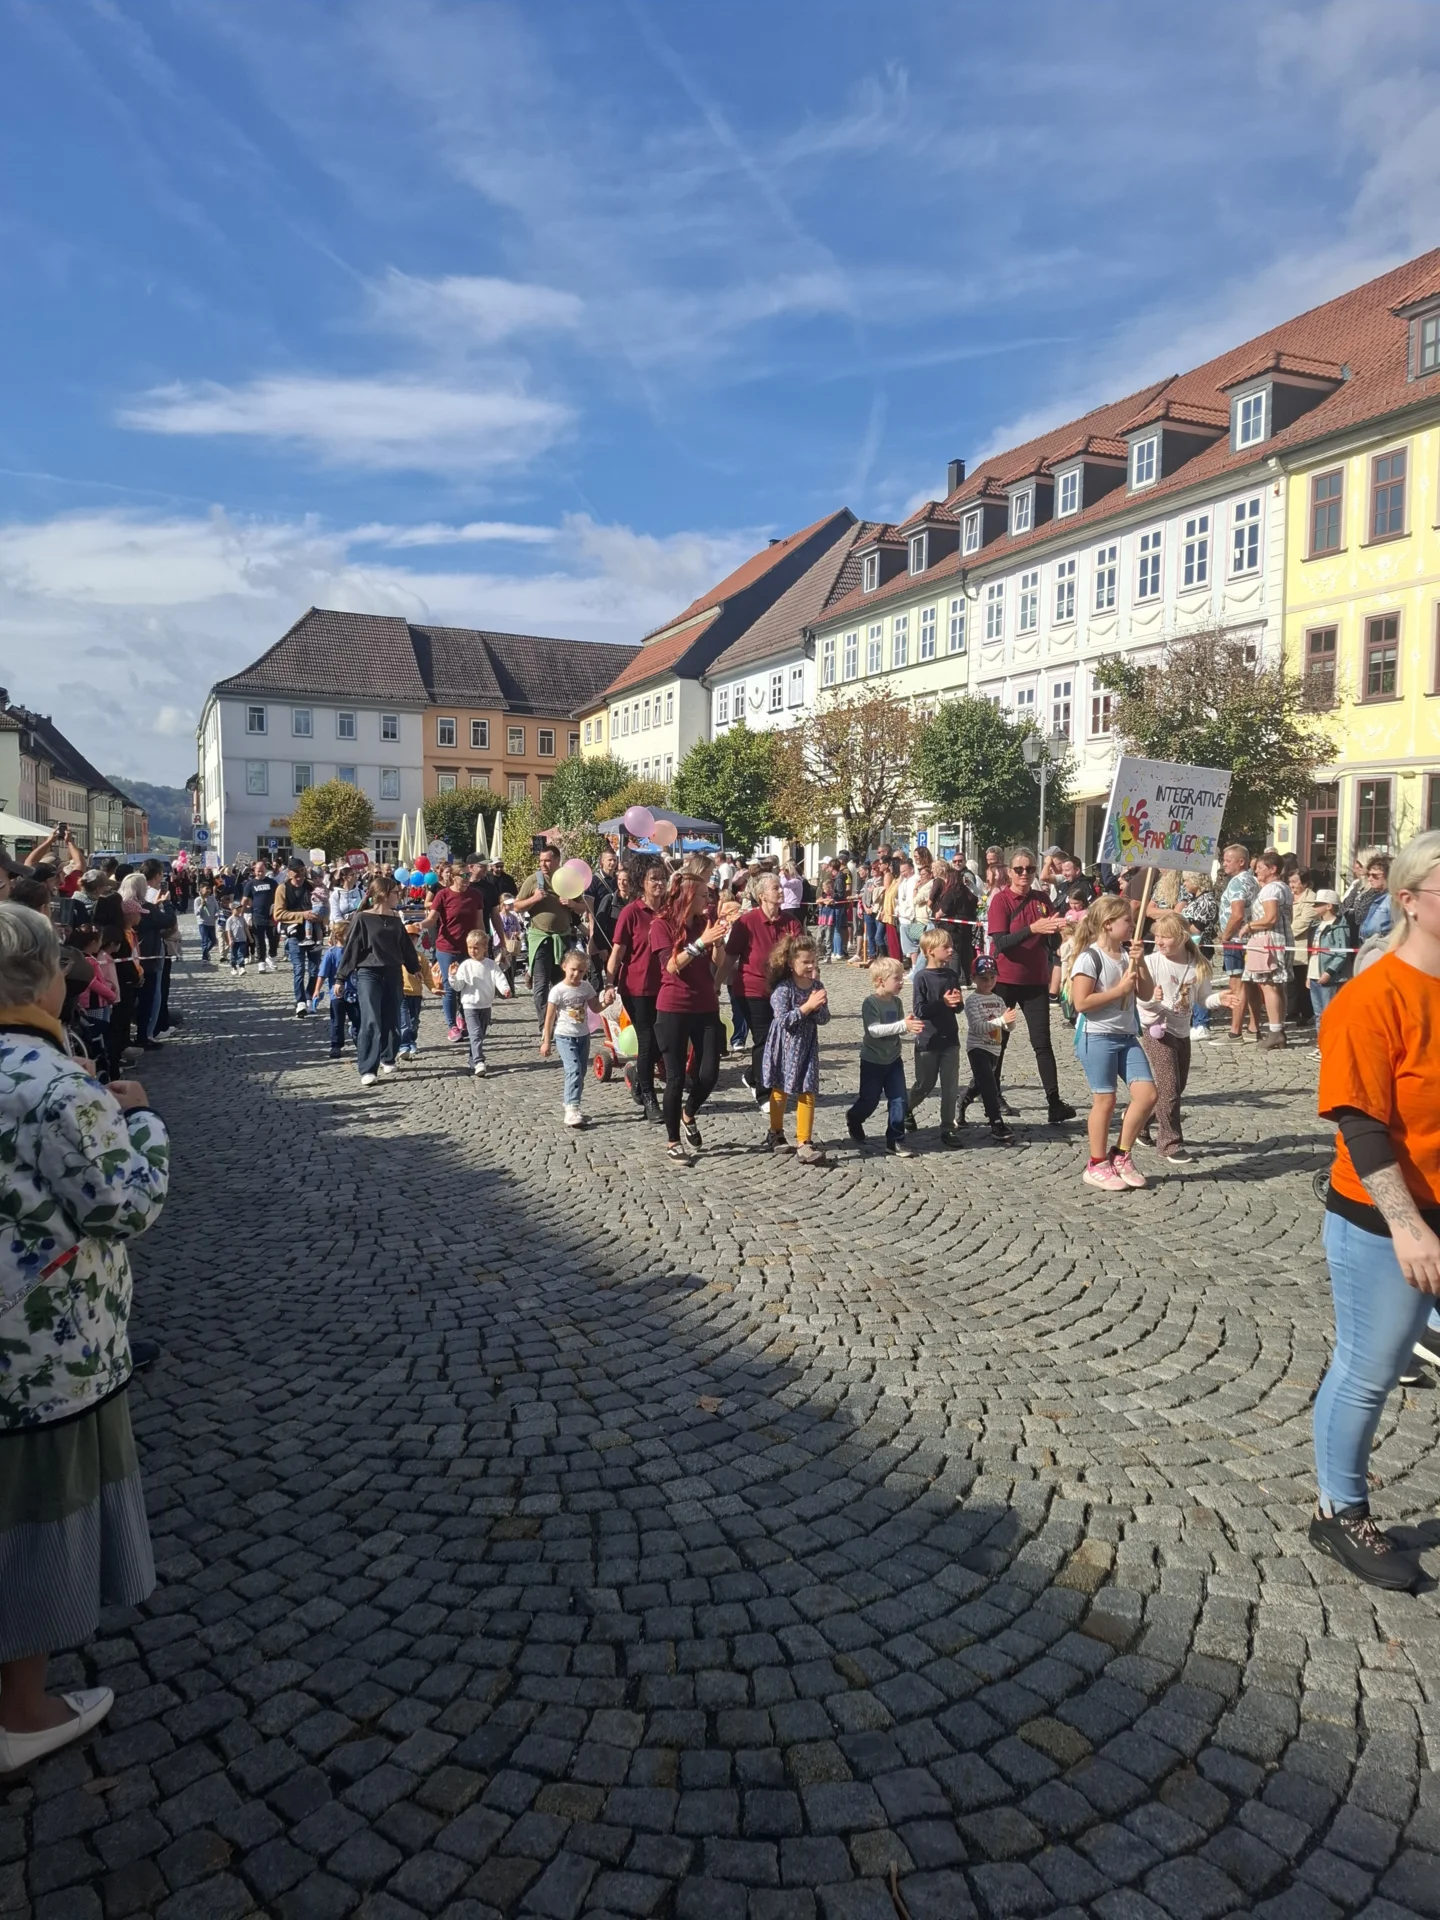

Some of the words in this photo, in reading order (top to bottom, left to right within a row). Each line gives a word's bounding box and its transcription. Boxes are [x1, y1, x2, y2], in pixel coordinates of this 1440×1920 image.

[1156, 785, 1226, 807] INTEGRATIVE
[1168, 805, 1193, 820] KITA
[1170, 820, 1187, 833] DIE
[1144, 830, 1216, 855] FARBKLECKSE
